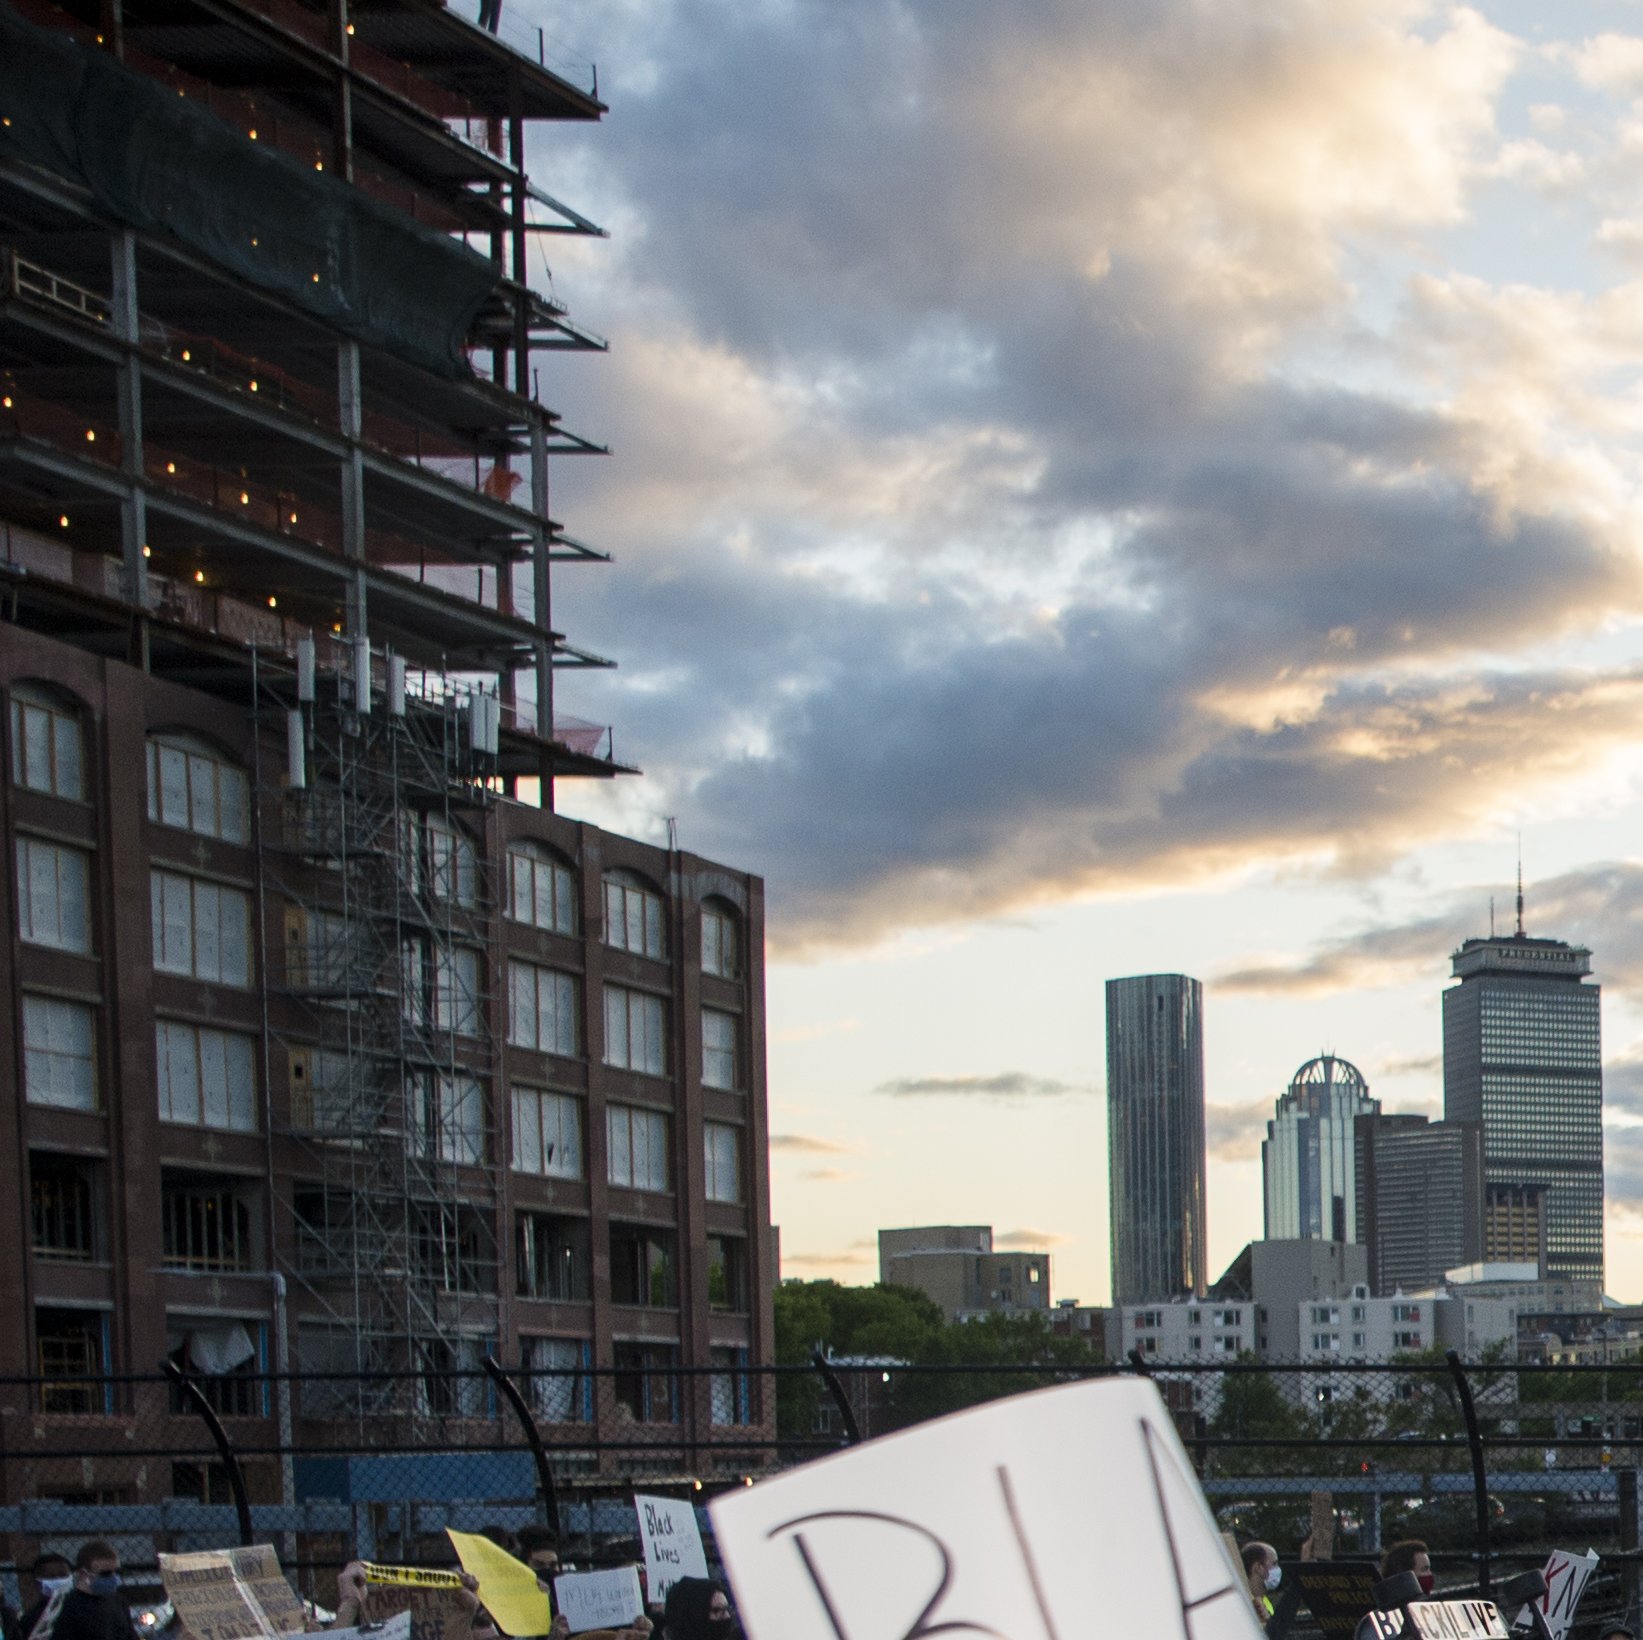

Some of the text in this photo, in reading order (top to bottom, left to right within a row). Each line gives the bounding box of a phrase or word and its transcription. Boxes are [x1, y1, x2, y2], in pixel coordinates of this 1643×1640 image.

[644, 1504, 675, 1537] Black
[653, 1541, 681, 1564] Lives
[1298, 1575, 1351, 1589] DEFUND
